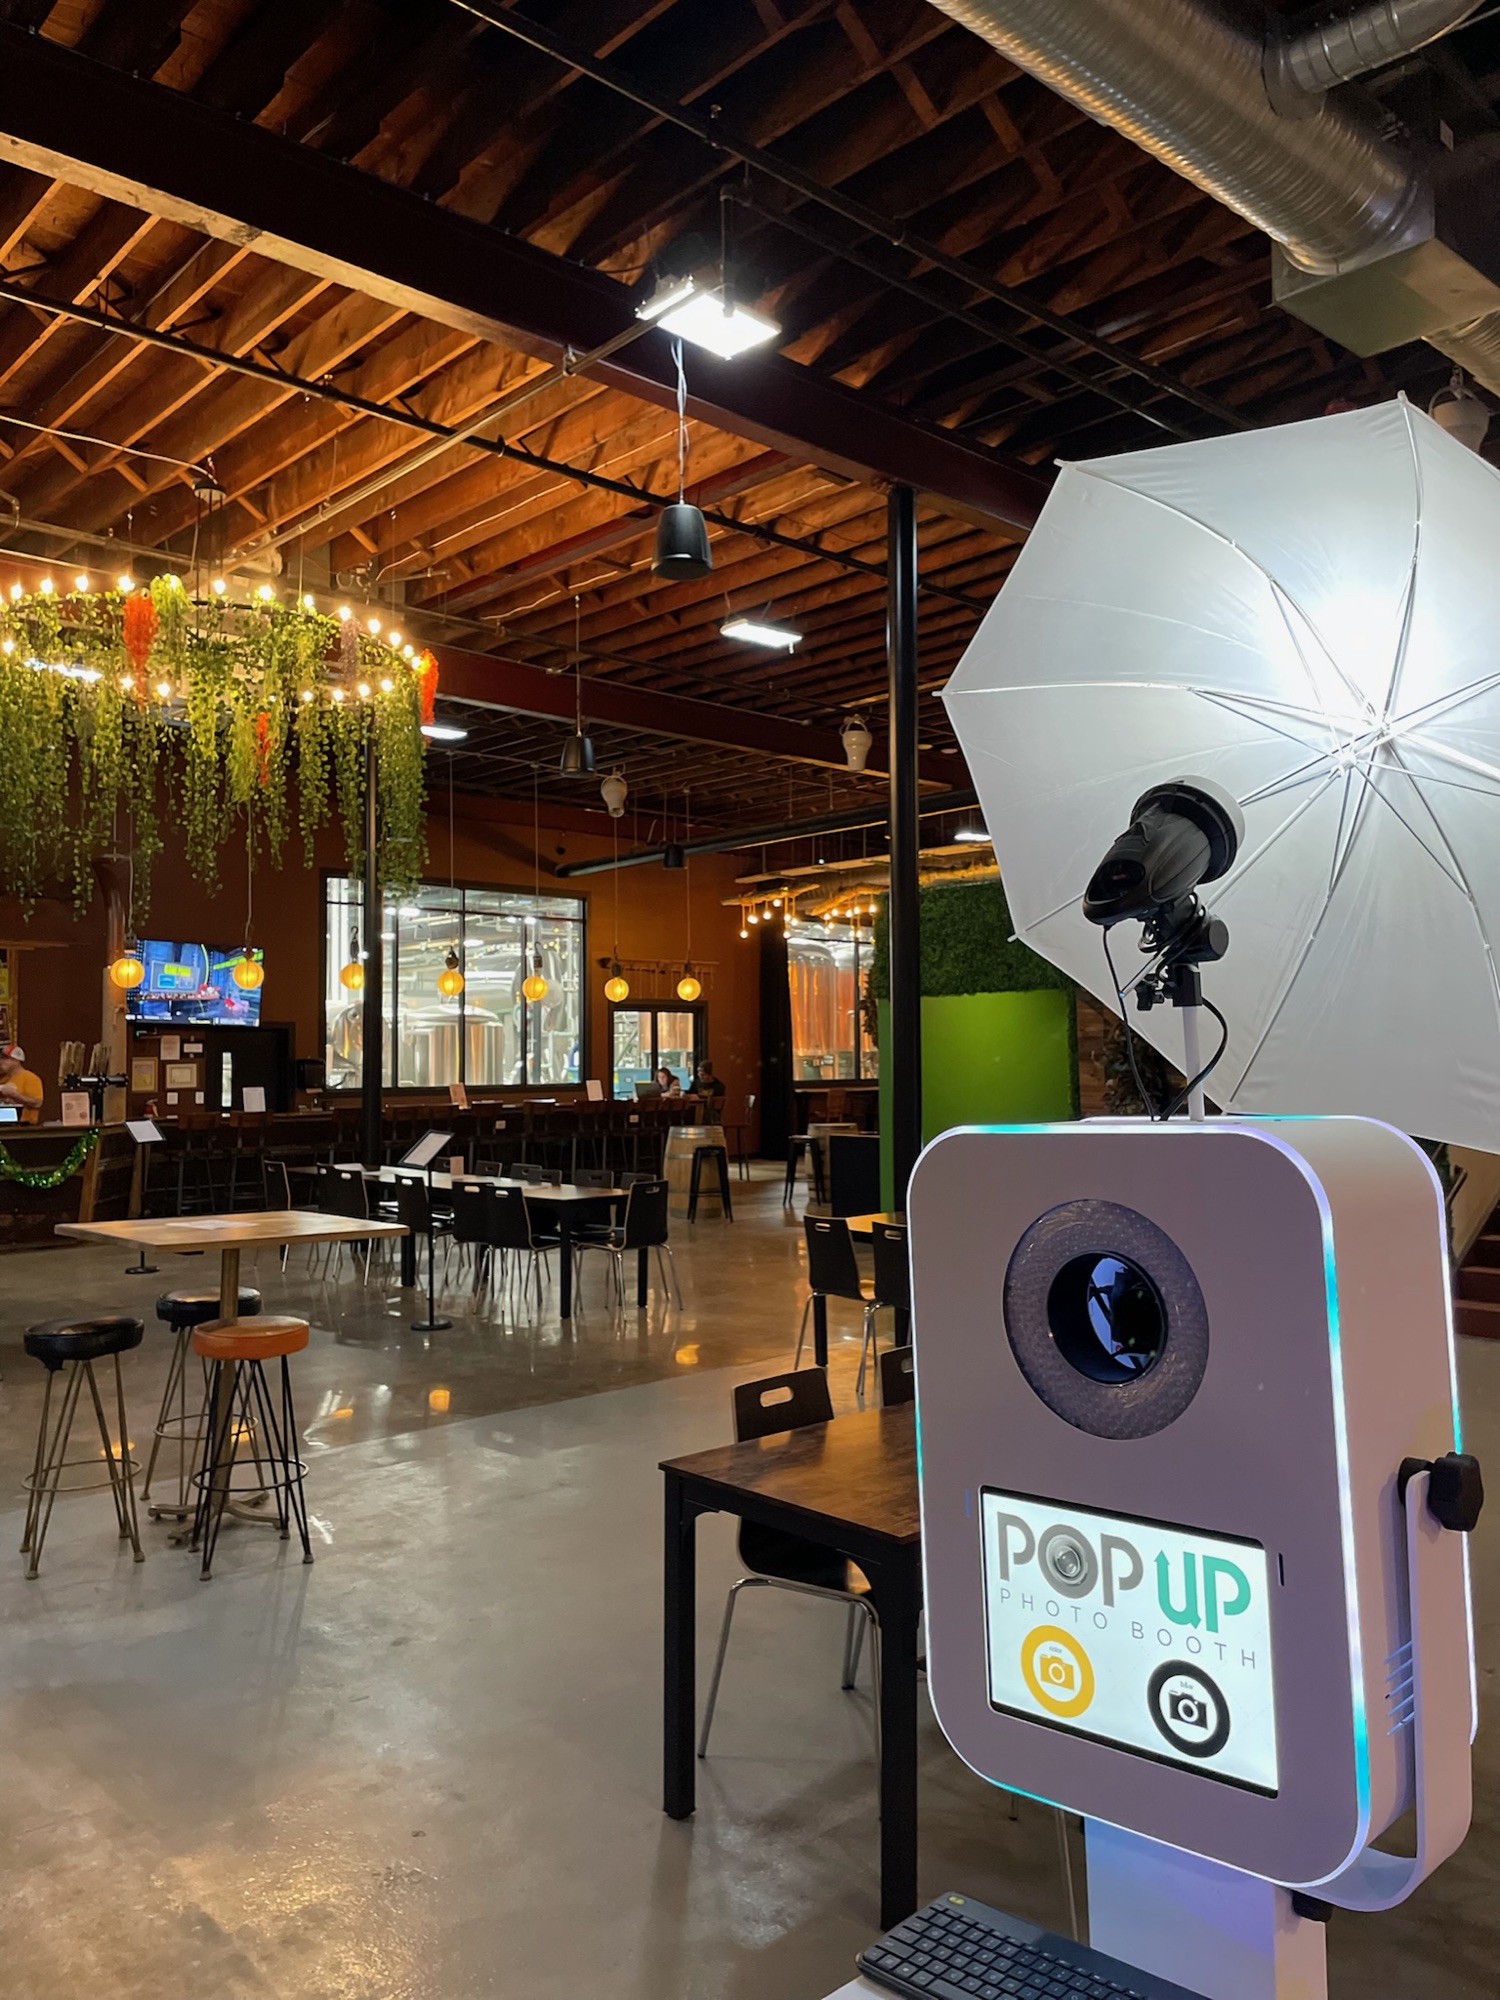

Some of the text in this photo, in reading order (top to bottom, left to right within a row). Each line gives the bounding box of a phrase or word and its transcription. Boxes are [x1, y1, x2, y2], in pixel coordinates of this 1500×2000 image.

[997, 1511, 1252, 1634] POP UP
[1000, 1587, 1256, 1670] PHOTO BOOTH
